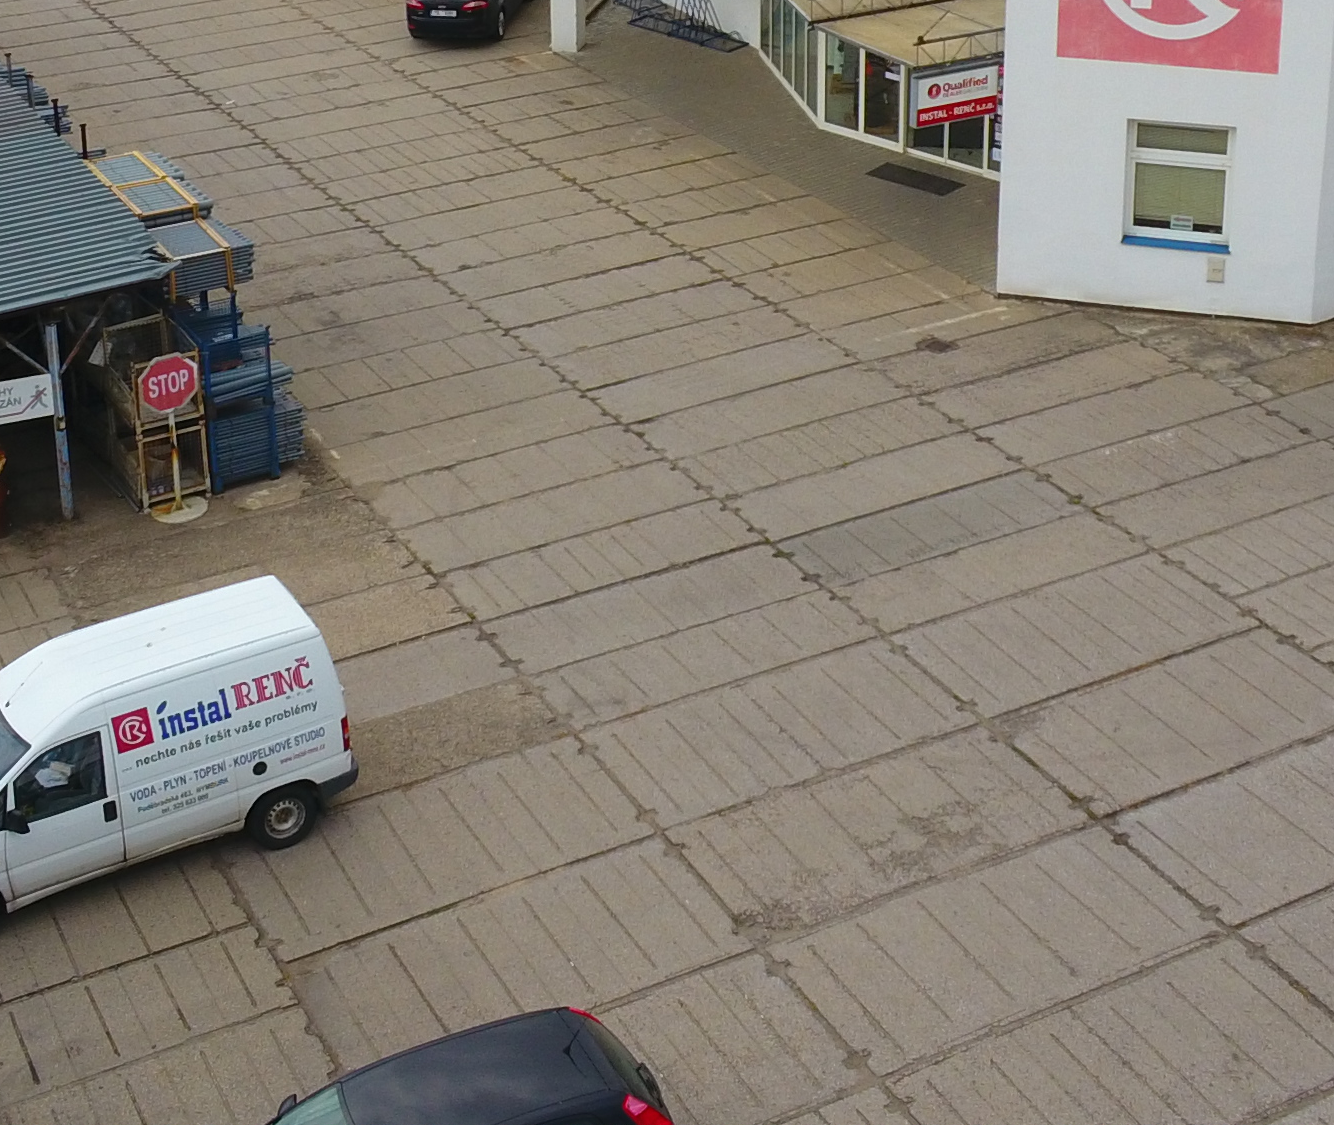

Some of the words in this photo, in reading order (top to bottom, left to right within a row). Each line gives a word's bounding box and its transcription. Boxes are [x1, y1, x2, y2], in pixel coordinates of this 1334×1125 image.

[943, 75, 988, 93] Qualified
[919, 109, 948, 122] INSTAL
[148, 368, 189, 399] STOP
[156, 688, 232, 740] instal
[231, 656, 313, 711] RENČ
[180, 734, 202, 754] nás
[234, 715, 262, 736] vaše
[265, 700, 318, 727] problémy
[130, 785, 157, 803] VODA
[163, 775, 187, 792] PLYN
[193, 759, 227, 781] TOPENÍ
